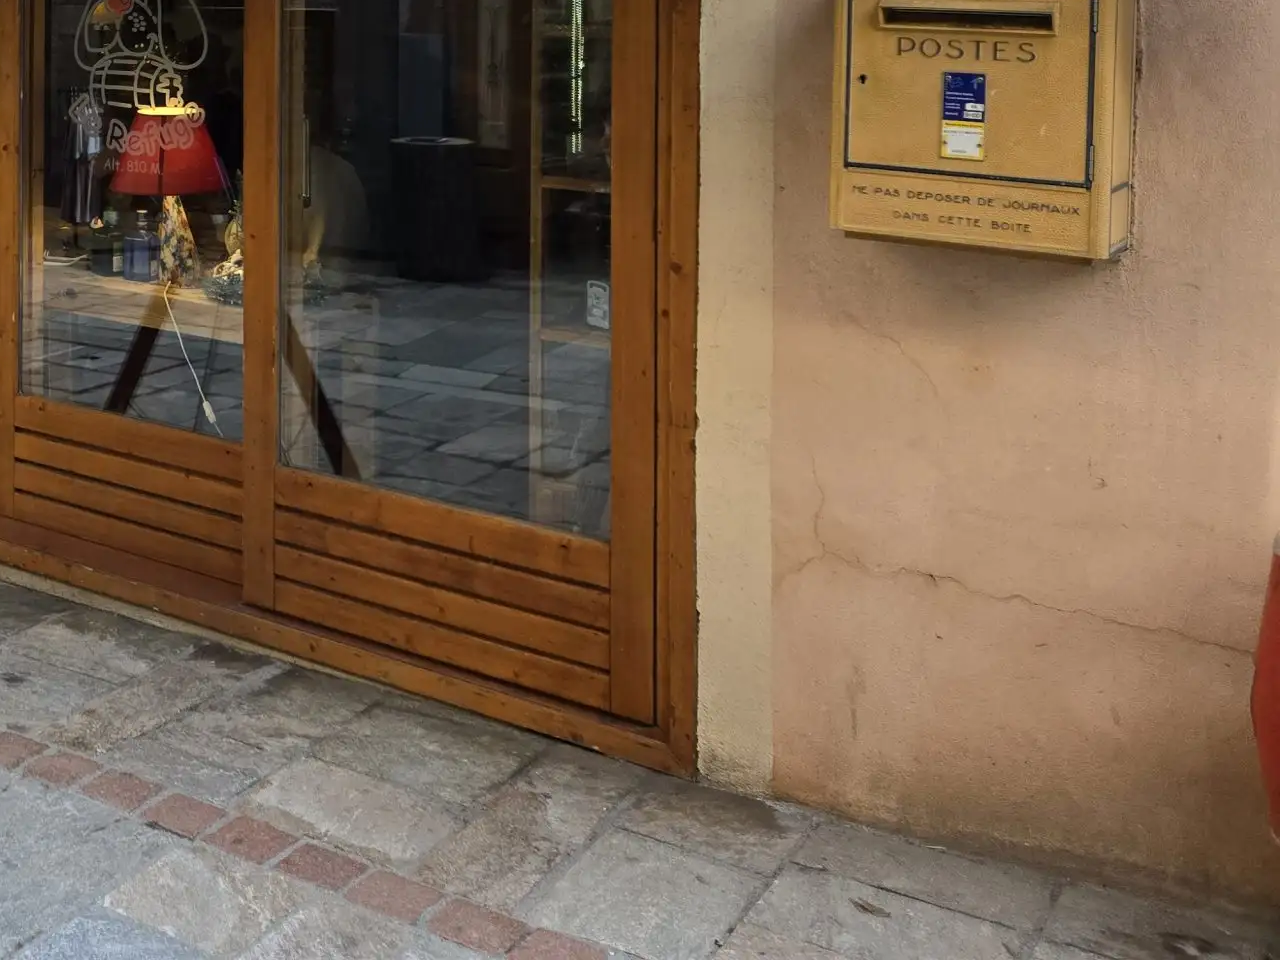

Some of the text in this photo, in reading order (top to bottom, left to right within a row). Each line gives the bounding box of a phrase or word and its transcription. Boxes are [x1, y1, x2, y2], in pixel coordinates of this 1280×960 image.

[895, 36, 1037, 63] POSTES
[105, 101, 206, 156] Refuge
[874, 186, 901, 198] PAS
[906, 189, 971, 206] DEPOSER
[976, 196, 996, 208] DE
[1001, 199, 1081, 217] JOURNAUX
[892, 209, 1032, 234] DANS CETTE BOITE
